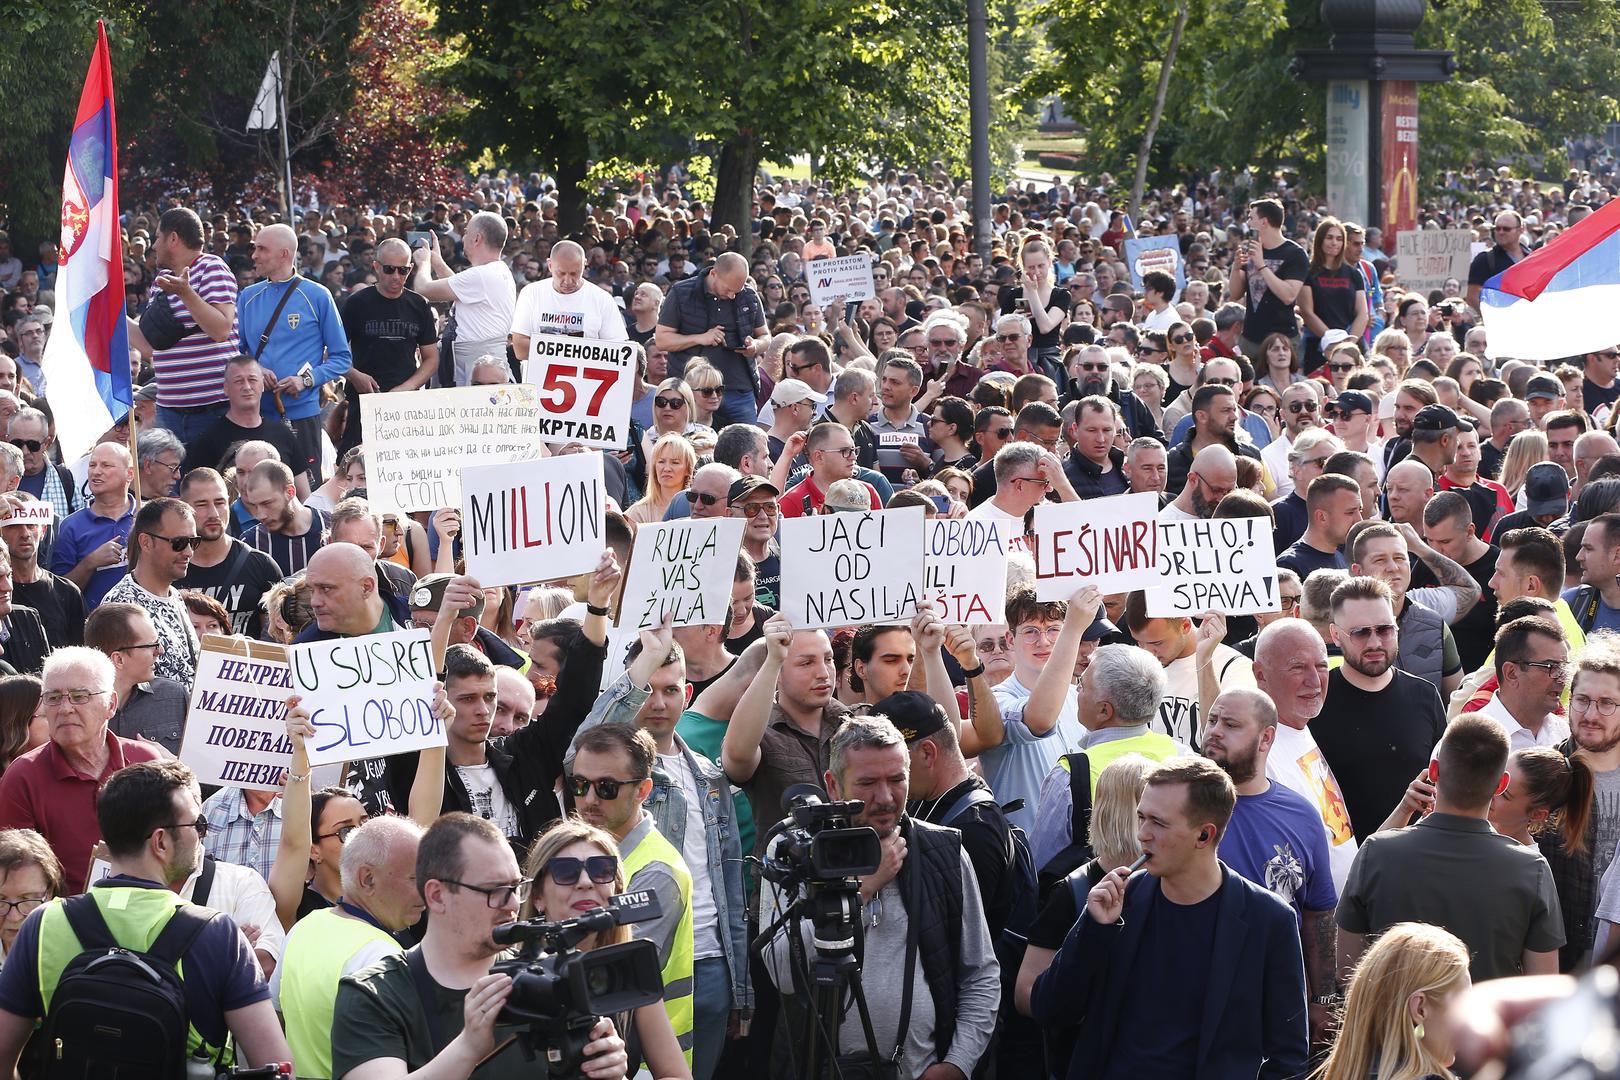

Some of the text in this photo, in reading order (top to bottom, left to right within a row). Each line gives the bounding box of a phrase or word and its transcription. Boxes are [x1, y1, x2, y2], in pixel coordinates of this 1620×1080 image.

[823, 257, 863, 267] PROTESTOM
[536, 340, 633, 367] ОБРЕНОВАЦ?
[540, 363, 619, 417] 57
[539, 418, 617, 442] КРТАВА
[882, 435, 916, 443] ШЉАМ
[394, 481, 448, 508] СТОП
[13, 507, 49, 518] ЉАМ
[471, 479, 598, 556] MIILION
[808, 512, 885, 552] JAČI
[925, 520, 1004, 557] OBODA
[1158, 519, 1254, 548] TIHO!
[1035, 519, 1157, 579] LEŠINARI
[835, 553, 871, 582] OD
[926, 565, 955, 588] ILI
[924, 589, 992, 622] ŠTA
[1173, 576, 1273, 610] SPAVA!
[295, 639, 433, 691] U SUSRET
[219, 760, 290, 786] ПЕНЗИ
[618, 893, 639, 906] RTV
